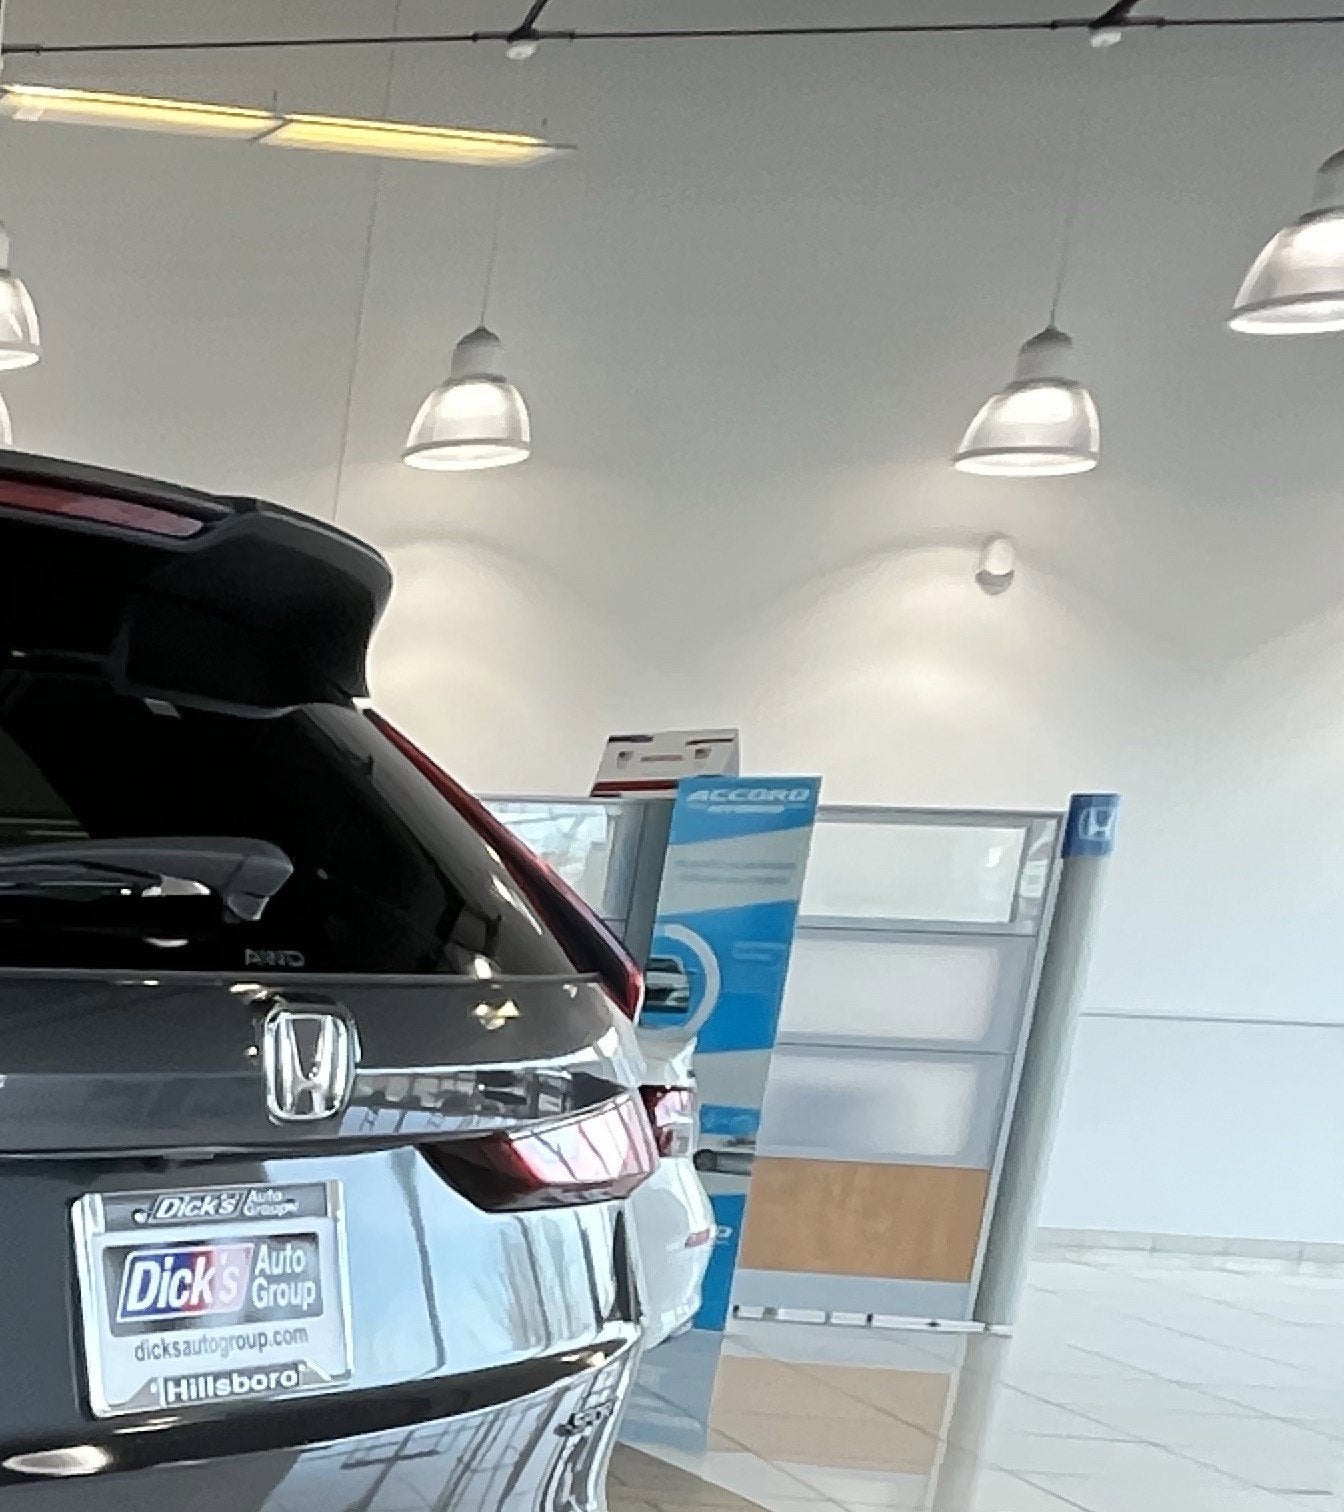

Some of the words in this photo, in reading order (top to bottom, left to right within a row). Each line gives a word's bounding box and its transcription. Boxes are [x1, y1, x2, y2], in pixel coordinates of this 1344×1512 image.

[125, 1254, 240, 1311] Dick's
[255, 1243, 306, 1275] Auto
[252, 1277, 316, 1310] Group
[134, 1326, 309, 1362] dicksautogroup.com
[166, 1369, 298, 1404] Hillsboro
